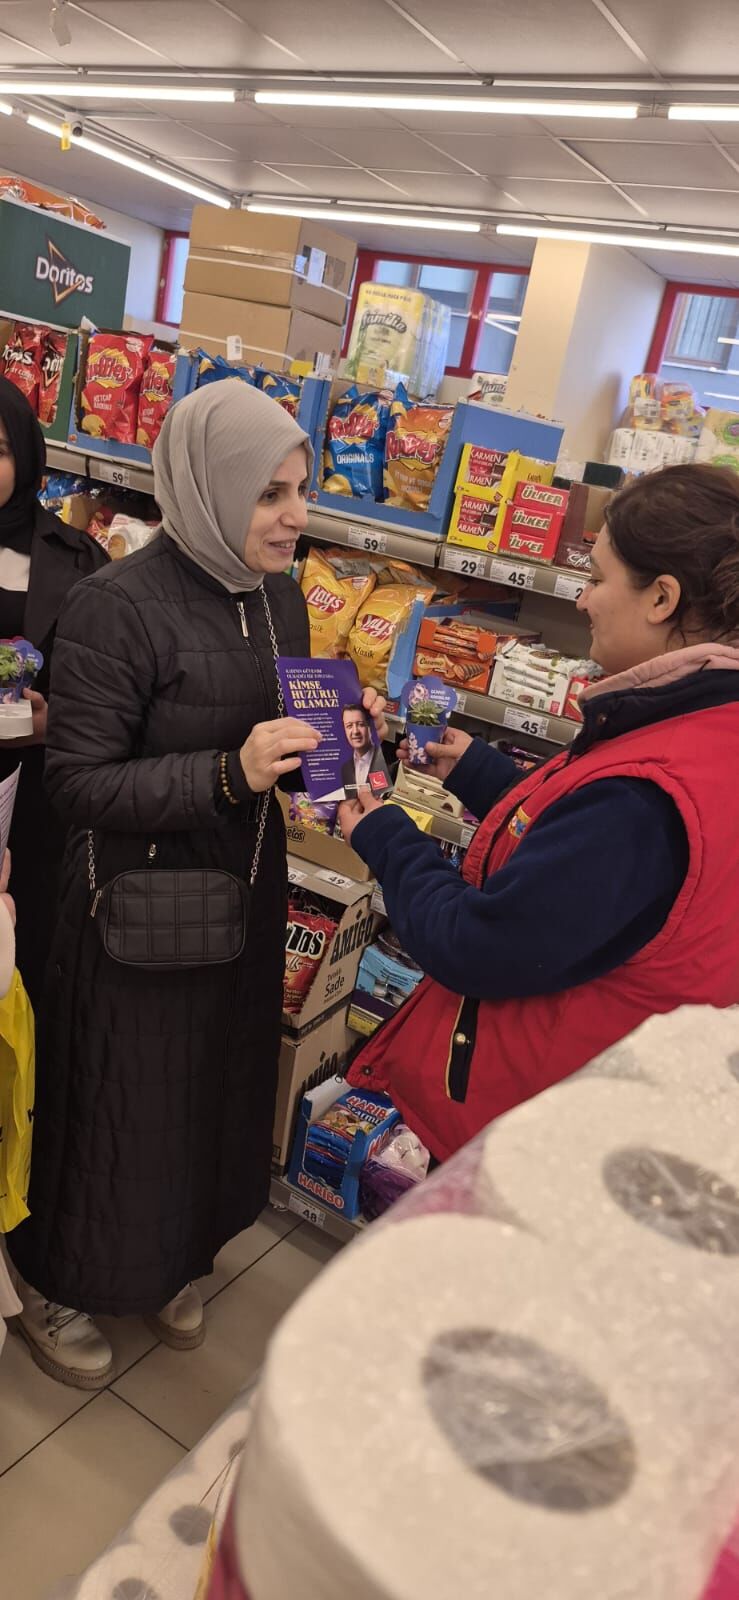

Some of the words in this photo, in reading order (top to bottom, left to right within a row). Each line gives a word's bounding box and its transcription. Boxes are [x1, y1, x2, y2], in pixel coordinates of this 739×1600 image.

[35, 256, 94, 294] Doritos
[336, 454, 375, 464] ORIGINALS
[112, 472, 124, 484] 59
[522, 485, 564, 507] ÜLKER
[462, 499, 491, 513] ARMEN
[457, 523, 485, 537] ARMEN
[364, 537, 378, 551] 59
[461, 559, 477, 574] 29
[508, 571, 526, 586] 45
[288, 678, 322, 690] KİMSE
[291, 688, 339, 699] HUZURLU
[293, 698, 339, 709] OLAMAZ!
[520, 720, 539, 735] 45
[328, 876, 345, 885] 49
[325, 975, 345, 998] Sade
[346, 1095, 389, 1119] HARIB
[298, 1171, 345, 1210] HARIBO
[302, 1208, 318, 1223] 48
